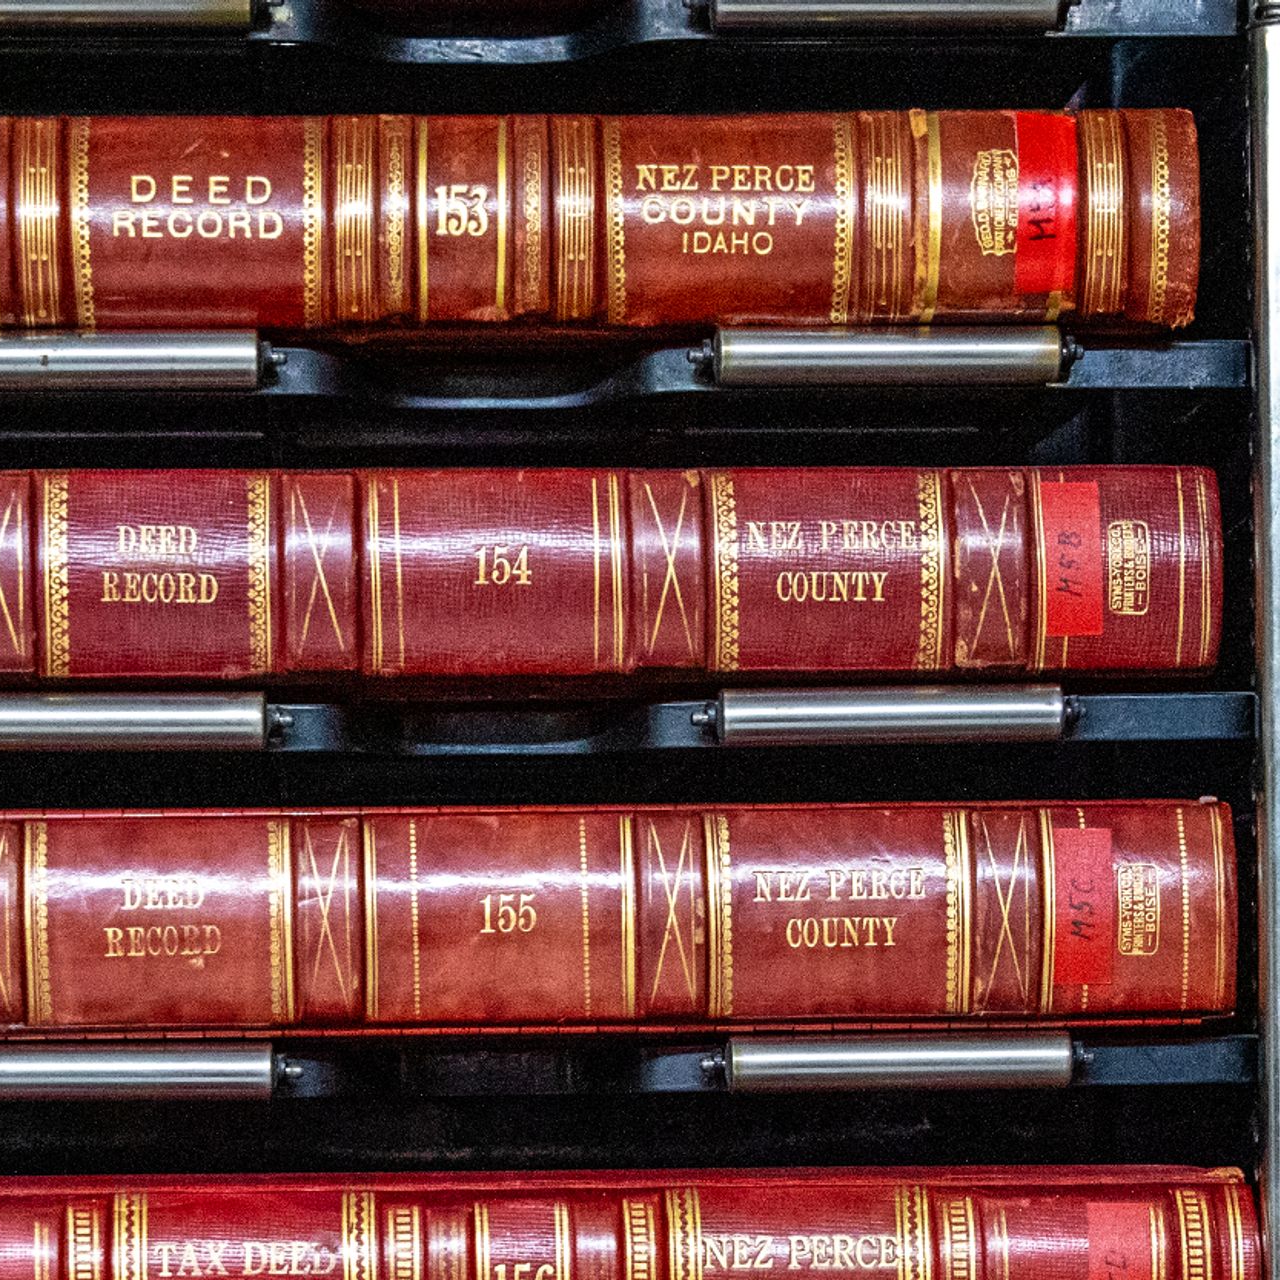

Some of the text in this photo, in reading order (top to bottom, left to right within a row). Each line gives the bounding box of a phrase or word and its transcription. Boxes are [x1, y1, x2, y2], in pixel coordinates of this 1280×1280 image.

[131, 175, 271, 203] DEED
[636, 164, 814, 193] NEZ PERCE
[112, 211, 283, 238] RECORD
[434, 186, 487, 235] 153
[642, 200, 811, 226] COUNTY
[682, 231, 774, 254] IDAHO
[117, 526, 196, 553] DEED
[747, 521, 917, 550] NEZ PERCE
[473, 547, 532, 585] 154
[101, 573, 218, 603] RECORD
[776, 572, 887, 602] COUNTY
[120, 880, 204, 910] DEED
[753, 869, 926, 902] NEZ PERCE
[477, 895, 536, 933] 155
[1145, 886, 1156, 932] BOISE
[104, 926, 221, 958] RECORD
[786, 917, 898, 948] COUNTY
[153, 1241, 337, 1276] TAX DEED
[702, 1235, 901, 1270] NEZ PERCE
